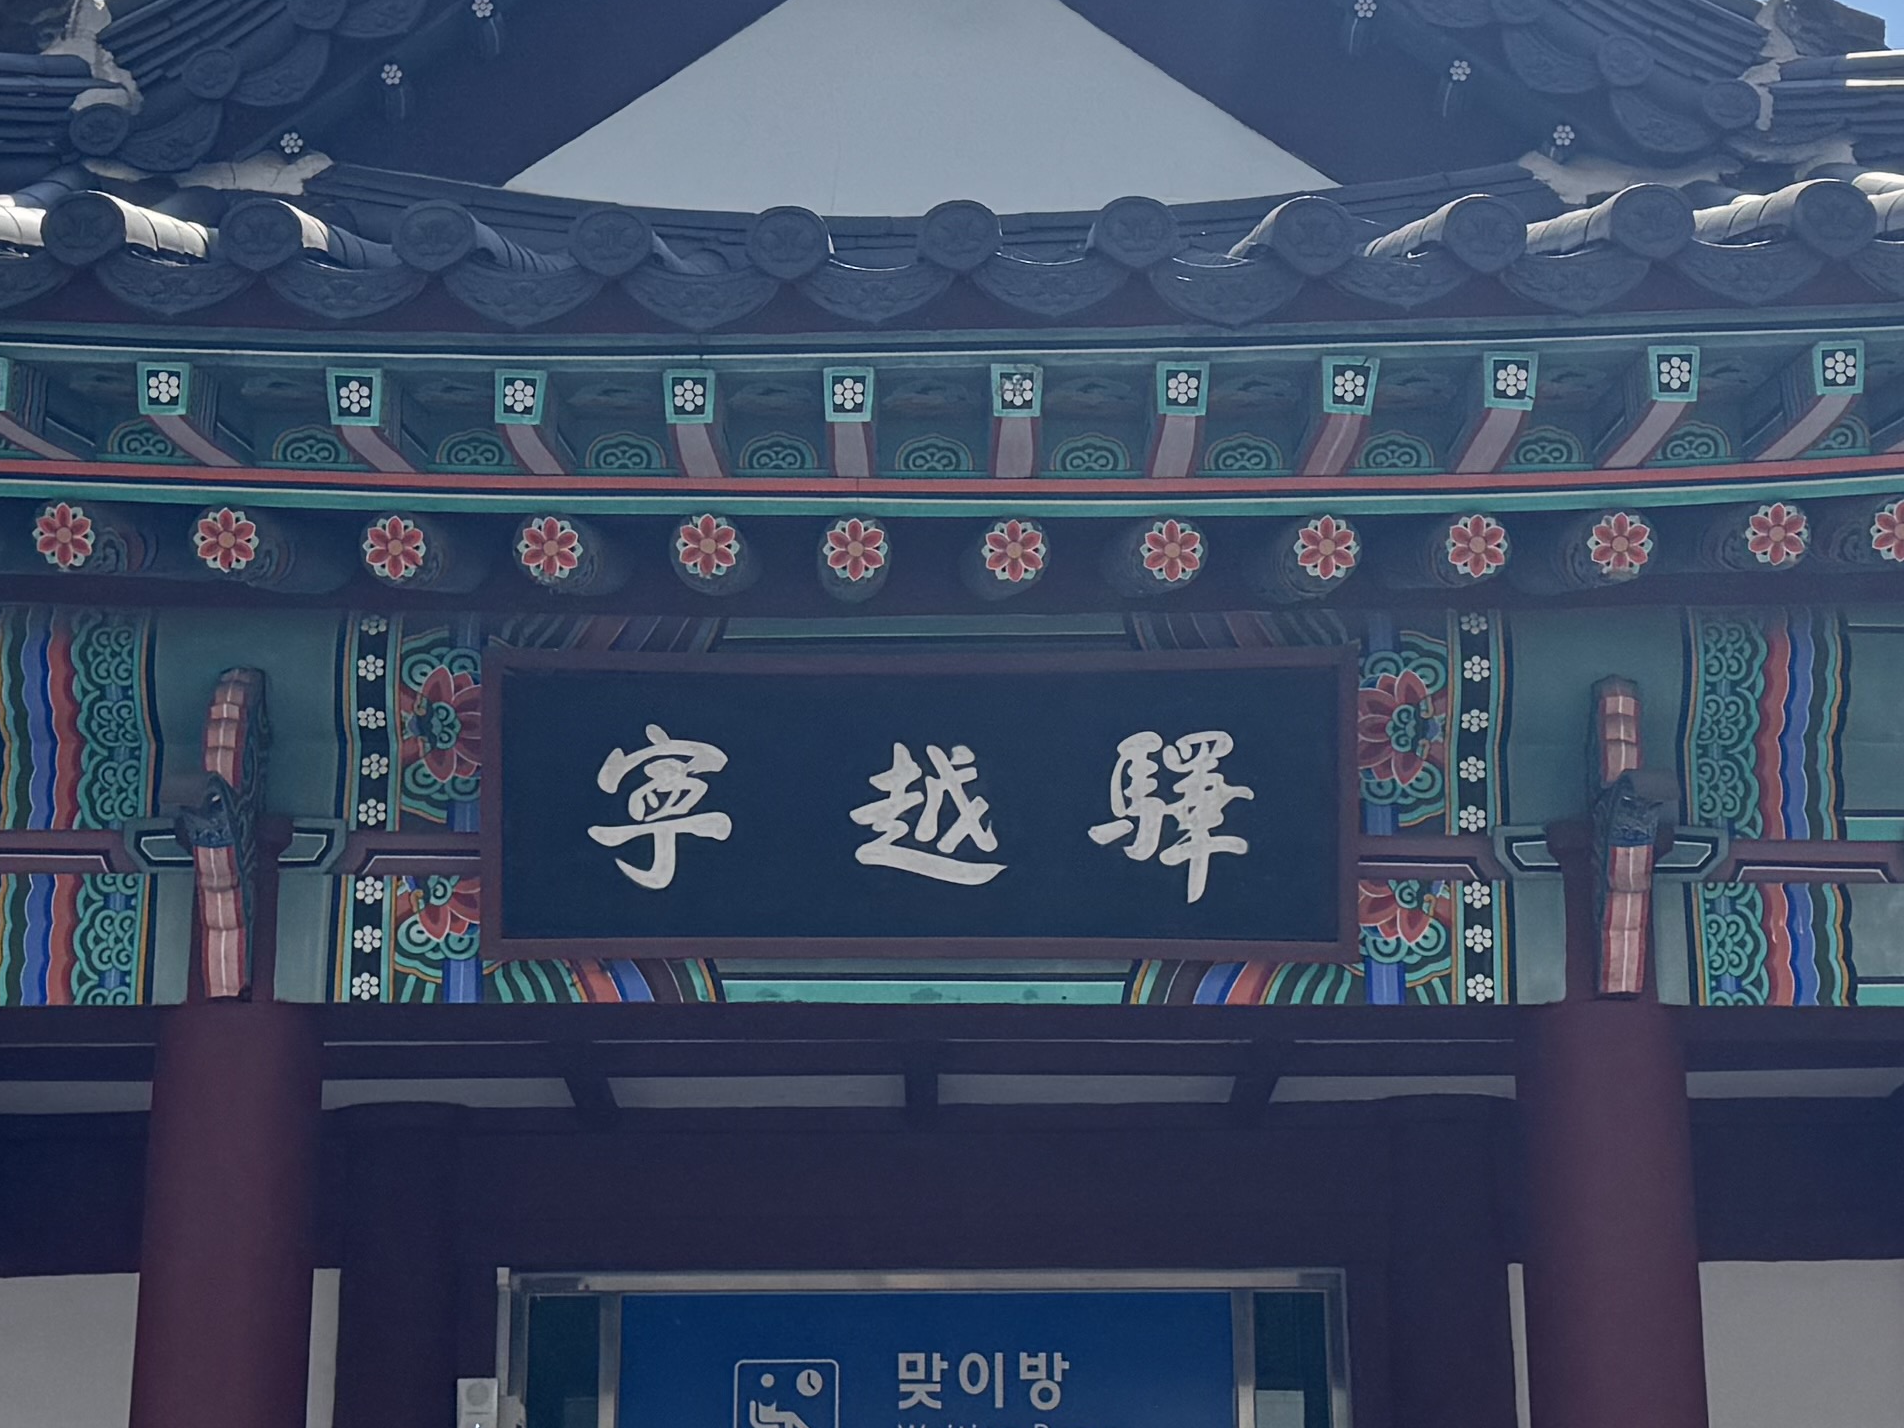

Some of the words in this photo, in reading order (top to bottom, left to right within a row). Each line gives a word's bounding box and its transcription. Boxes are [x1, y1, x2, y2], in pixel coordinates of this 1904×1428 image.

[587, 724, 1255, 904] 寧越驛
[897, 1351, 1070, 1410] 맞이방
